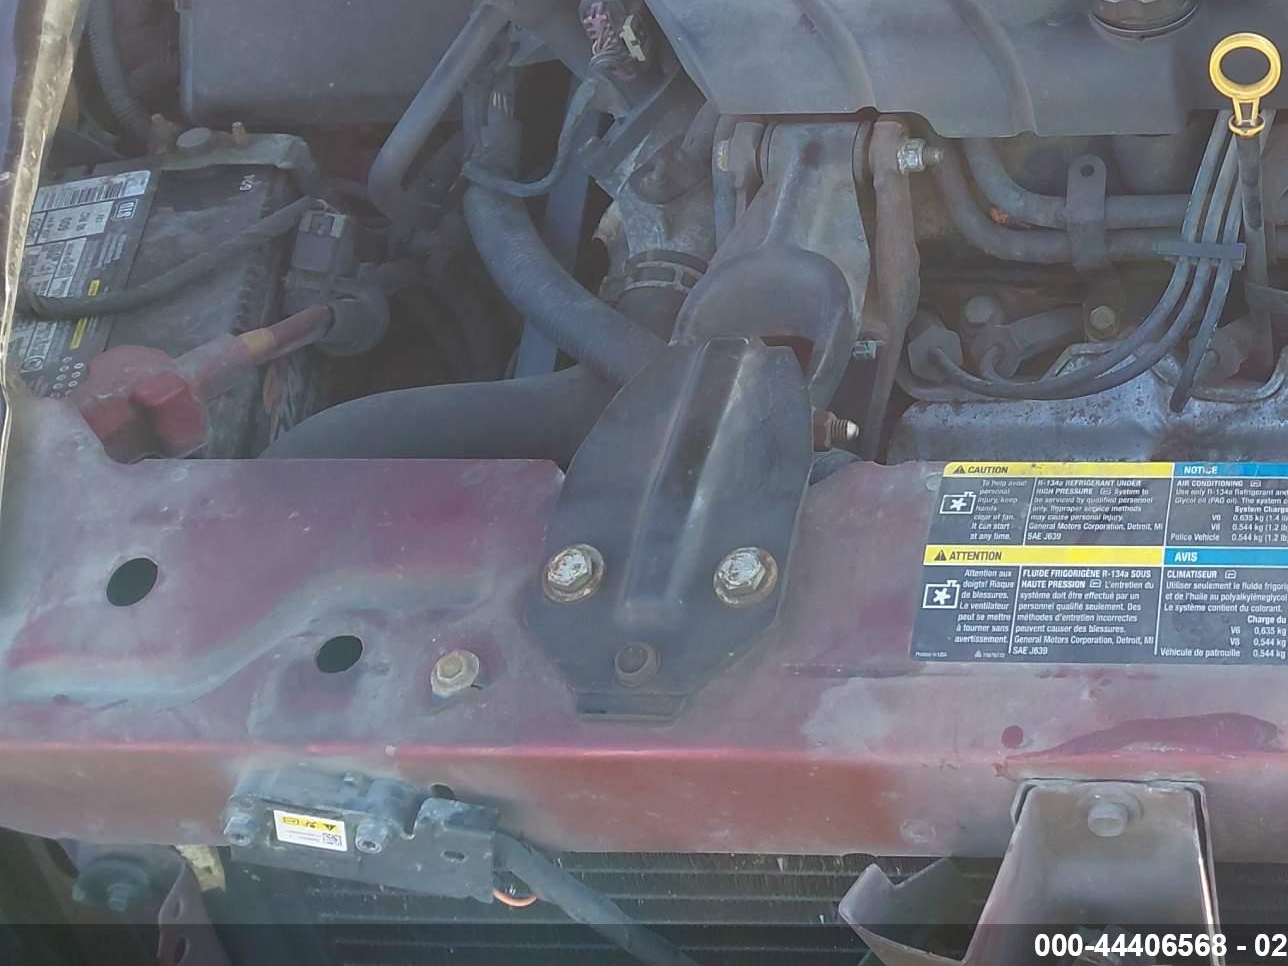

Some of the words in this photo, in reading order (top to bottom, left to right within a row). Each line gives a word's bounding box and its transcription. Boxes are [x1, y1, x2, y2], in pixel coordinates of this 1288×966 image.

[1184, 466, 1217, 474] NOTICE
[1083, 523, 1125, 531] Corporation,
[1127, 523, 1152, 531] Detroit,
[1253, 534, 1263, 542] kg
[1264, 534, 1278, 543] (1.2
[949, 552, 1002, 560] ATTENTION
[1175, 552, 1197, 561] AVIS
[963, 580, 988, 589] doigts!
[989, 580, 1014, 589] Risque
[1020, 592, 1050, 600] système
[1018, 603, 1054, 612] personnel
[1056, 603, 1083, 612] qualifié
[1175, 604, 1205, 612] système
[958, 613, 974, 622] peut
[1248, 616, 1274, 624] Charge
[1015, 625, 1045, 634] peuvent
[1277, 627, 1286, 636] kg
[1070, 636, 1114, 645] Corporation,
[1116, 636, 1142, 645] Detroit,
[1253, 639, 1275, 647] 0,544
[1277, 639, 1286, 648] kg
[1206, 649, 1240, 658] patrouille
[1253, 650, 1275, 659] 0,544
[1276, 650, 1285, 659] kg
